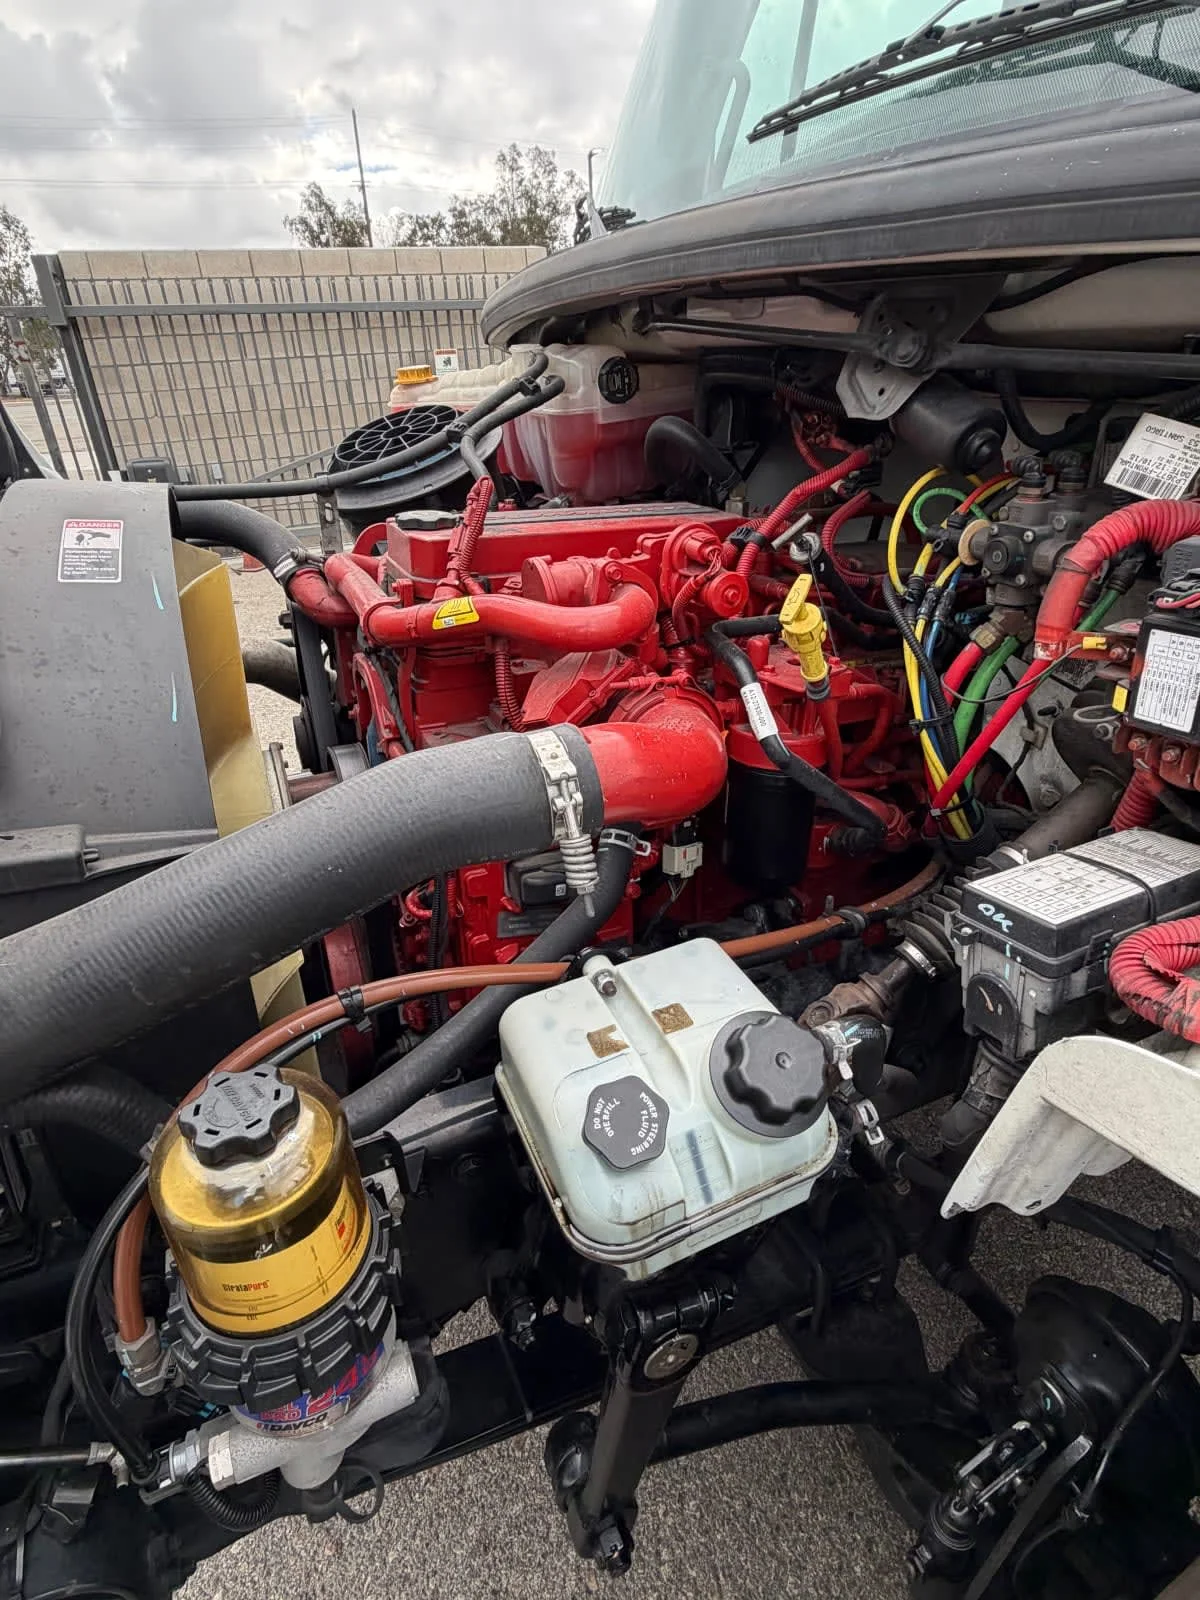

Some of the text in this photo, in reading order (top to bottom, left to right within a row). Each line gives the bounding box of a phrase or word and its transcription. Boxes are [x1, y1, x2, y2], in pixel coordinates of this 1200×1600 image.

[1145, 425, 1185, 442] SANTIAGO
[79, 521, 120, 529] DANGER
[593, 1097, 606, 1130] DO NOT
[602, 1097, 621, 1137] OVERFILL
[630, 1091, 659, 1156] POWER STEERING
[637, 1109, 650, 1139] FLUID
[270, 1412, 328, 1431] DAVCO
